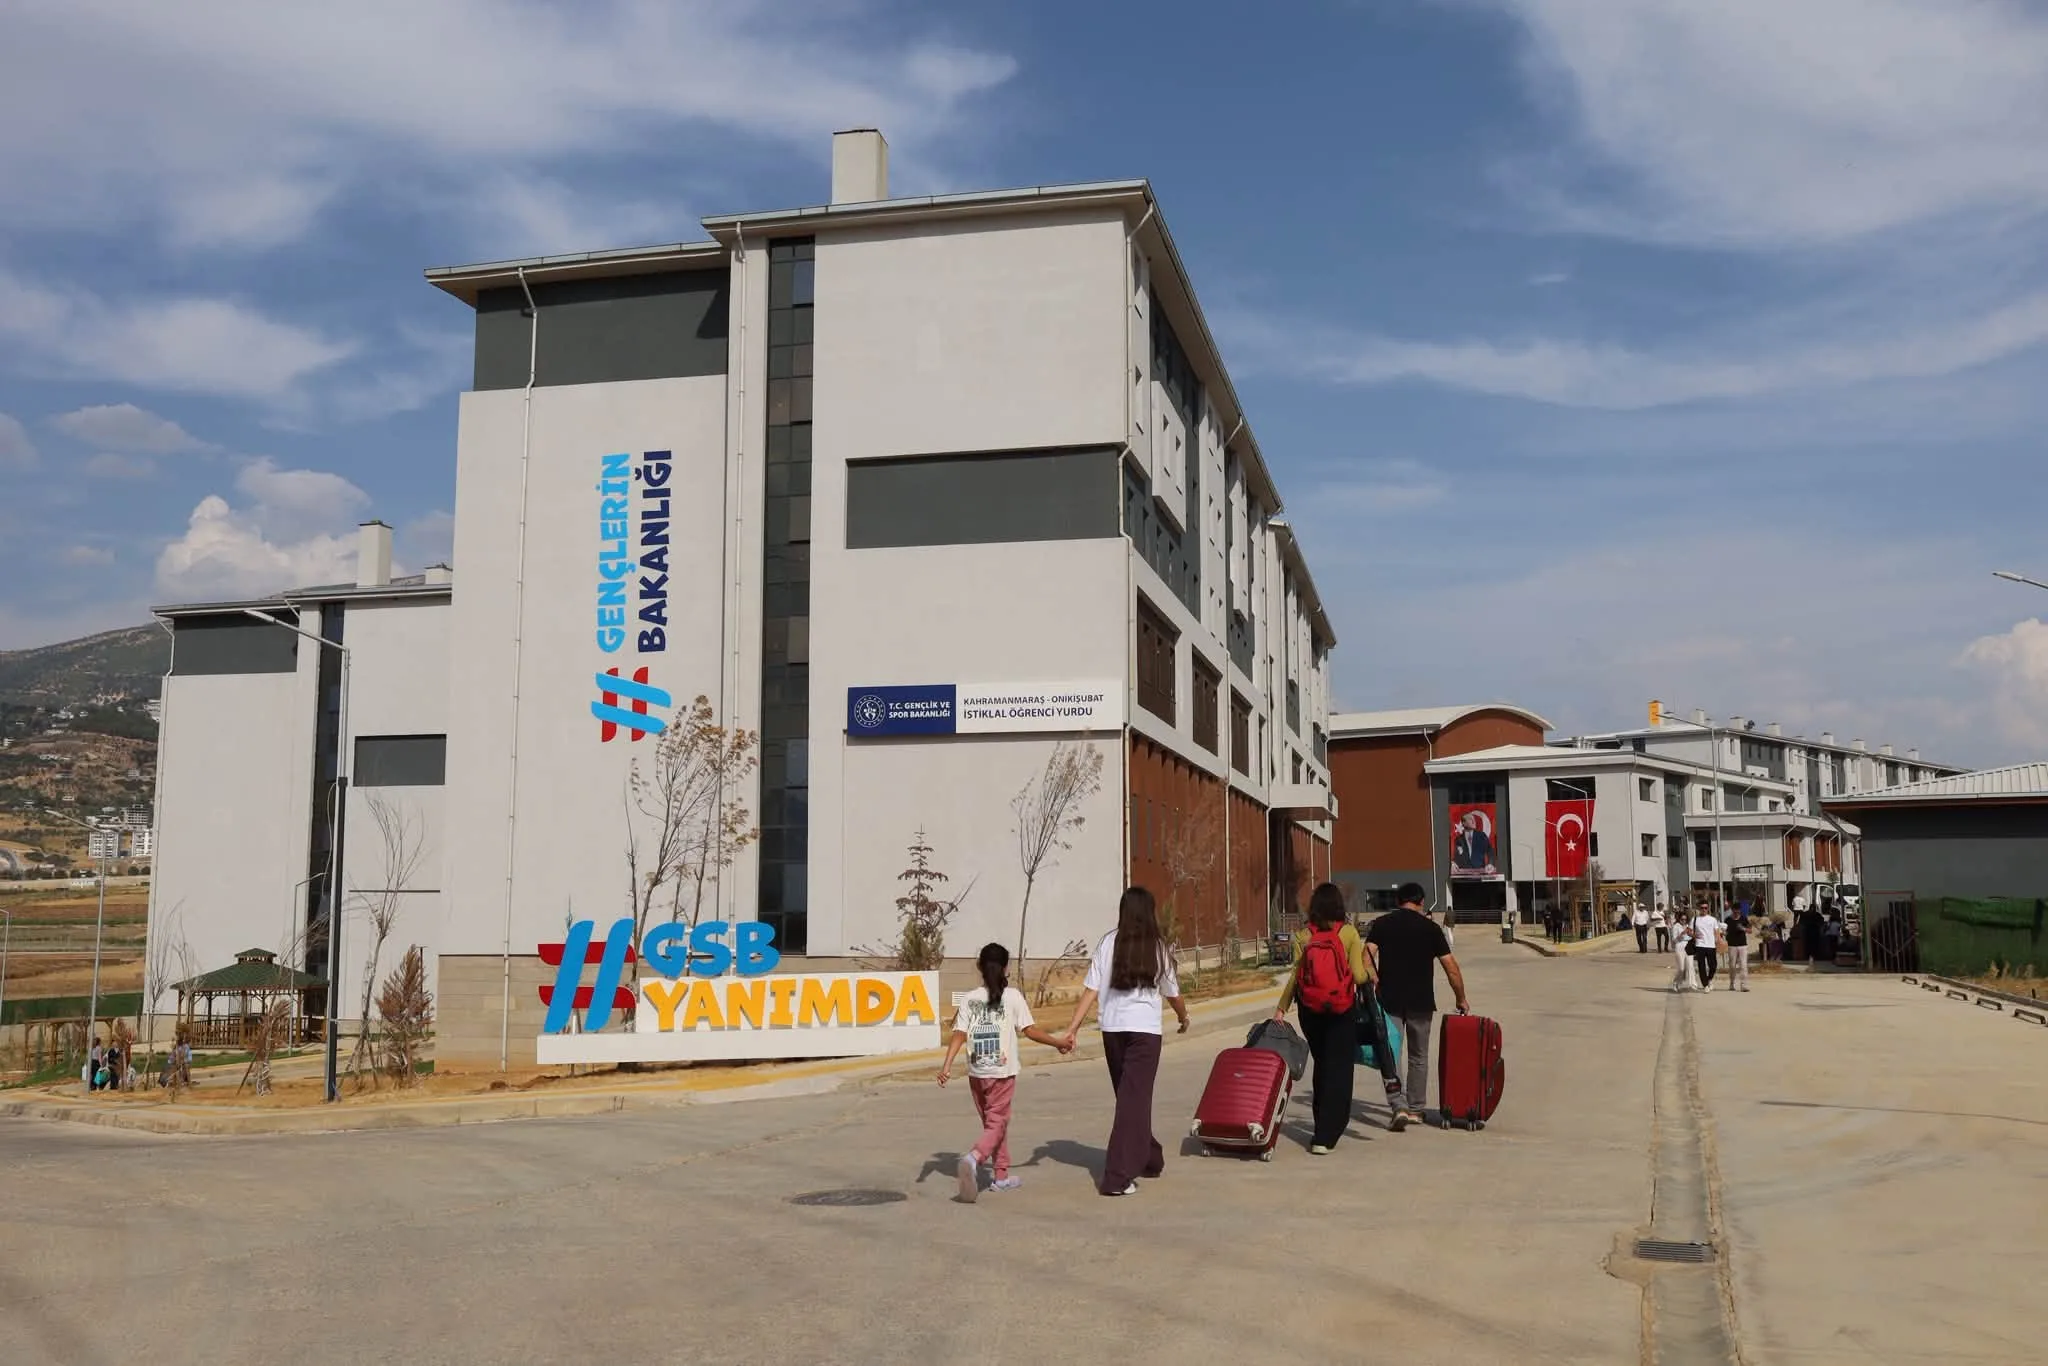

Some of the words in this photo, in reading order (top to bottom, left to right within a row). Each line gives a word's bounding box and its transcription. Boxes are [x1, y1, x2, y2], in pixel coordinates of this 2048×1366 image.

[596, 453, 636, 653] GENÇLERİN
[634, 450, 672, 653] BAKANLIĞI
[888, 702, 903, 710] T.C.
[904, 700, 938, 710] GENÇLİK
[940, 701, 951, 709] VE
[888, 711, 908, 719] SPOR
[910, 709, 951, 718] BAKANLIĞI
[963, 695, 1045, 705] KAHRAMANMARAŞ
[963, 707, 1007, 719] İSTİKLAL
[1008, 705, 1055, 718] ÖĞRENCİ
[1056, 706, 1093, 717] YURDU
[642, 920, 780, 978] GSB
[642, 975, 936, 1033] YANIMDA
